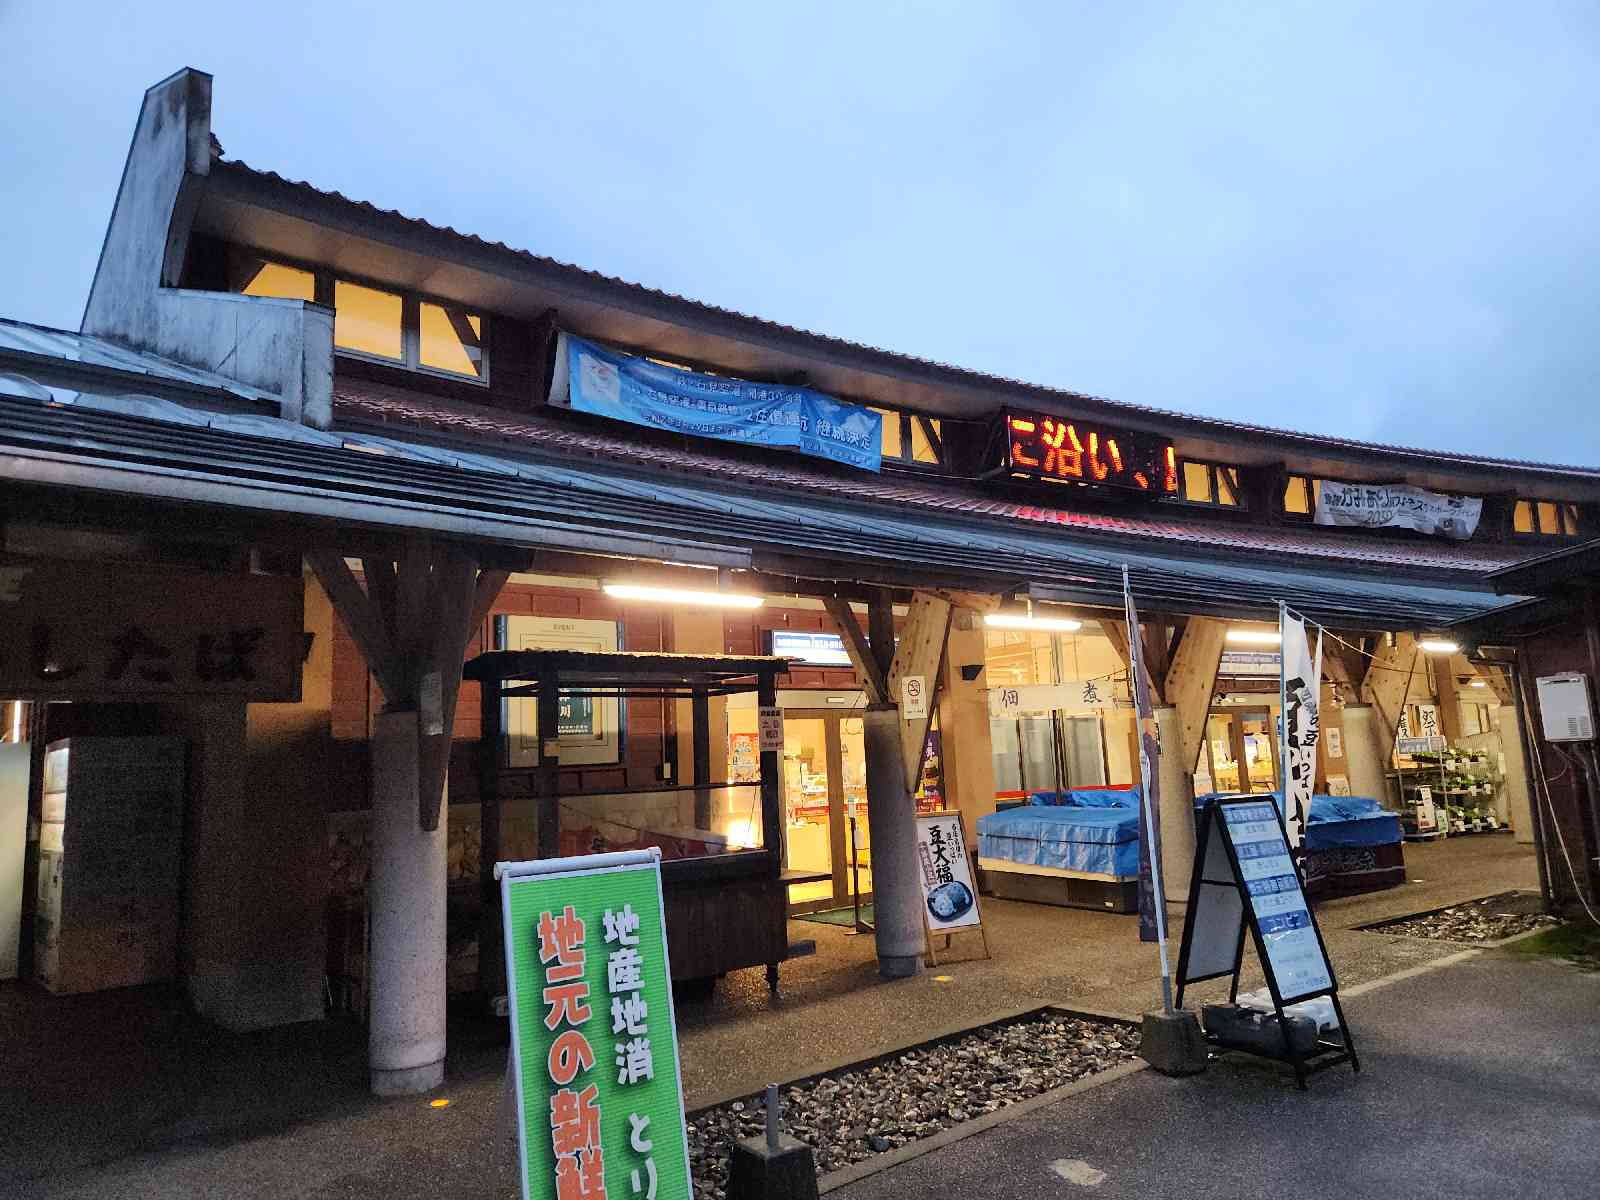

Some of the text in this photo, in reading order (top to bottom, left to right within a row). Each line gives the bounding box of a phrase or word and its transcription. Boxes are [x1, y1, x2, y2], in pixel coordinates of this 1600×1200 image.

[928, 825, 954, 884] 豆大福
[537, 905, 607, 1200] 地元の新鮮
[602, 904, 658, 1200] 地産地消 とり
